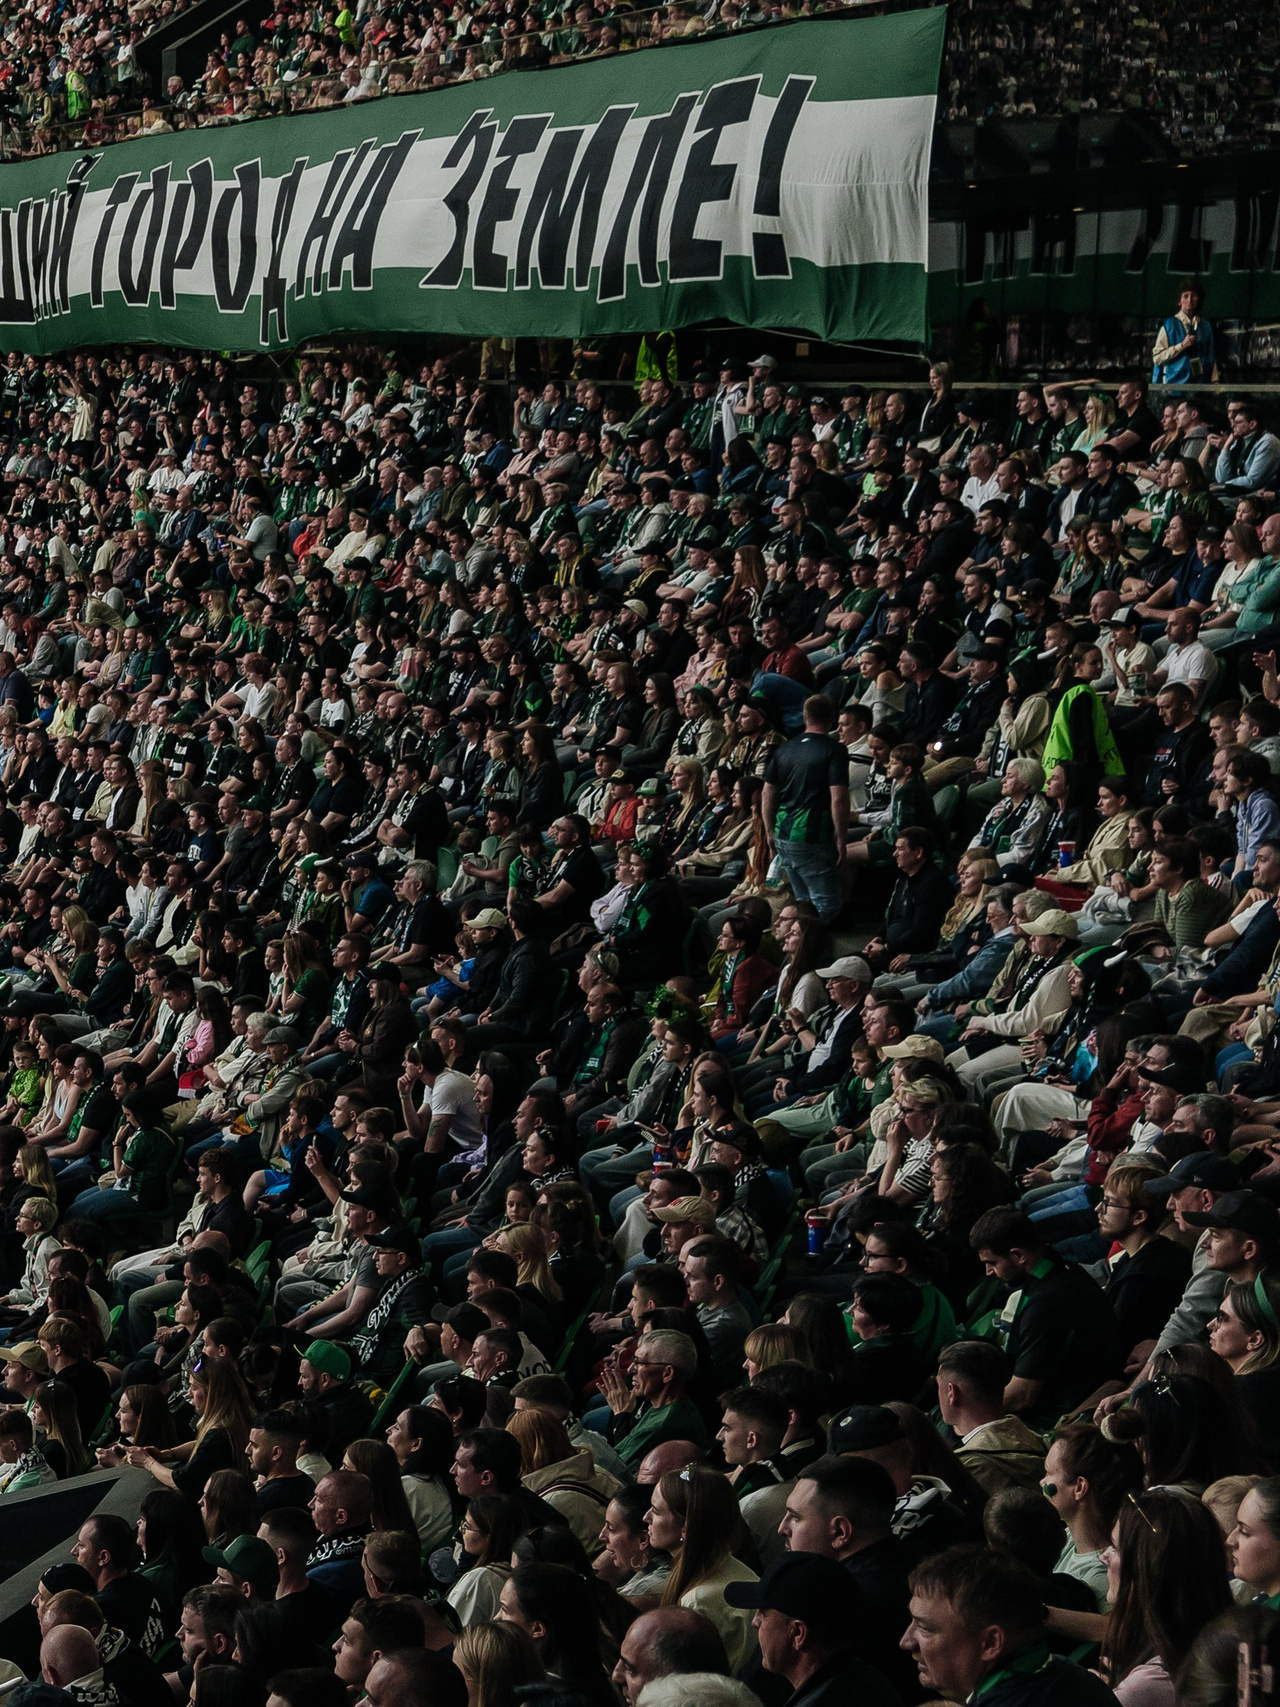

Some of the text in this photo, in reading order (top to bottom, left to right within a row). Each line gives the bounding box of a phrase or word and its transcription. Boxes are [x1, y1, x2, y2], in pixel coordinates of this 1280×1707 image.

[91, 156, 310, 345] ГОРОД
[293, 128, 424, 301] НА
[418, 73, 817, 305] ЗЕМЛЕ!
